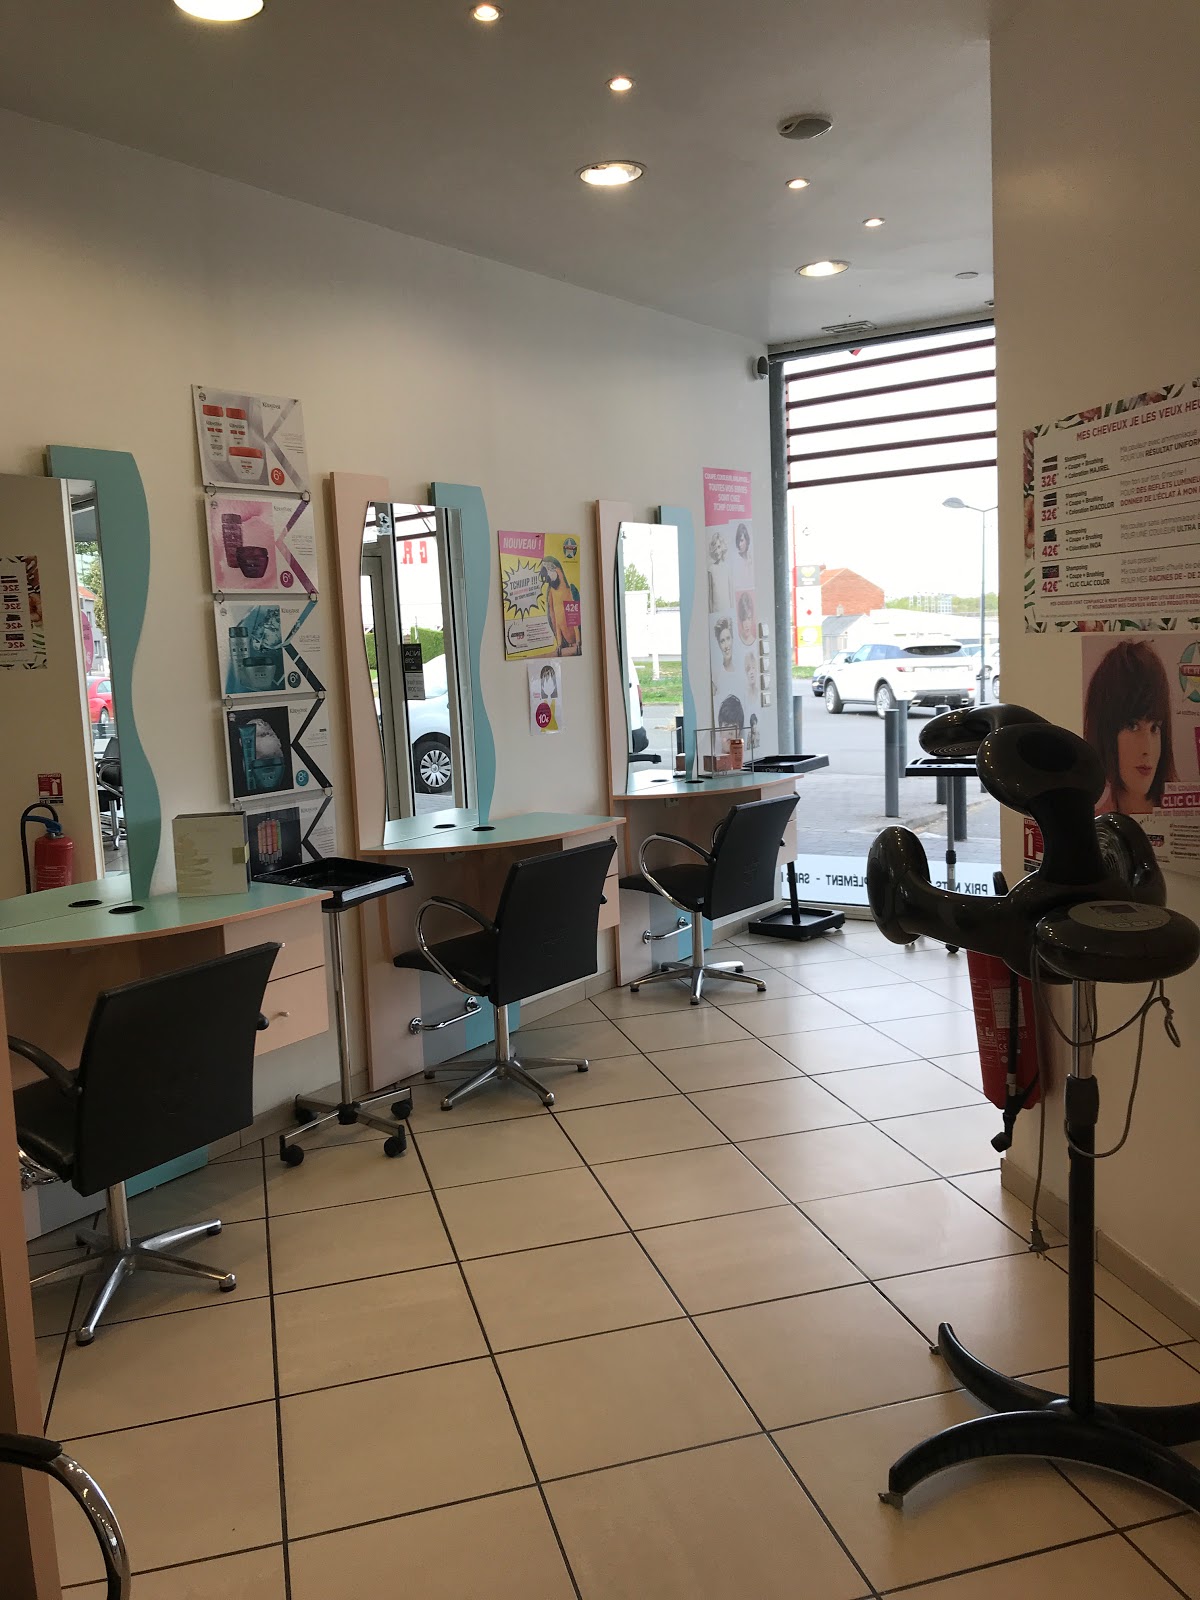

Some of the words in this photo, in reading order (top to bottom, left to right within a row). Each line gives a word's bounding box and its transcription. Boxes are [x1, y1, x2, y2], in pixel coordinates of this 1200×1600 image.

[1076, 429, 1091, 442] MES
[1092, 419, 1127, 437] CHEVEUX
[1129, 416, 1139, 427] JE
[1141, 411, 1157, 424] LES
[1159, 404, 1183, 419] VEUX
[1136, 485, 1147, 494] DES
[1148, 480, 1173, 491] REFLETS
[1120, 496, 1143, 507] DONNER
[1144, 494, 1152, 503] DE
[1153, 490, 1176, 501] L'ÉCLAT
[1183, 486, 1198, 496] MON
[1089, 501, 1115, 512] DIACOLOR
[1177, 523, 1197, 533] ULTRA
[503, 537, 537, 550] NOUVEAU
[538, 539, 542, 550] !
[1094, 578, 1111, 586] COLOR
[1149, 573, 1173, 582] RACINES
[1174, 572, 1183, 580] DE
[1188, 571, 1197, 579] DE
[565, 603, 579, 612] 42€
[1162, 795, 1184, 807] CLIC
[1186, 795, 1200, 806] CL
